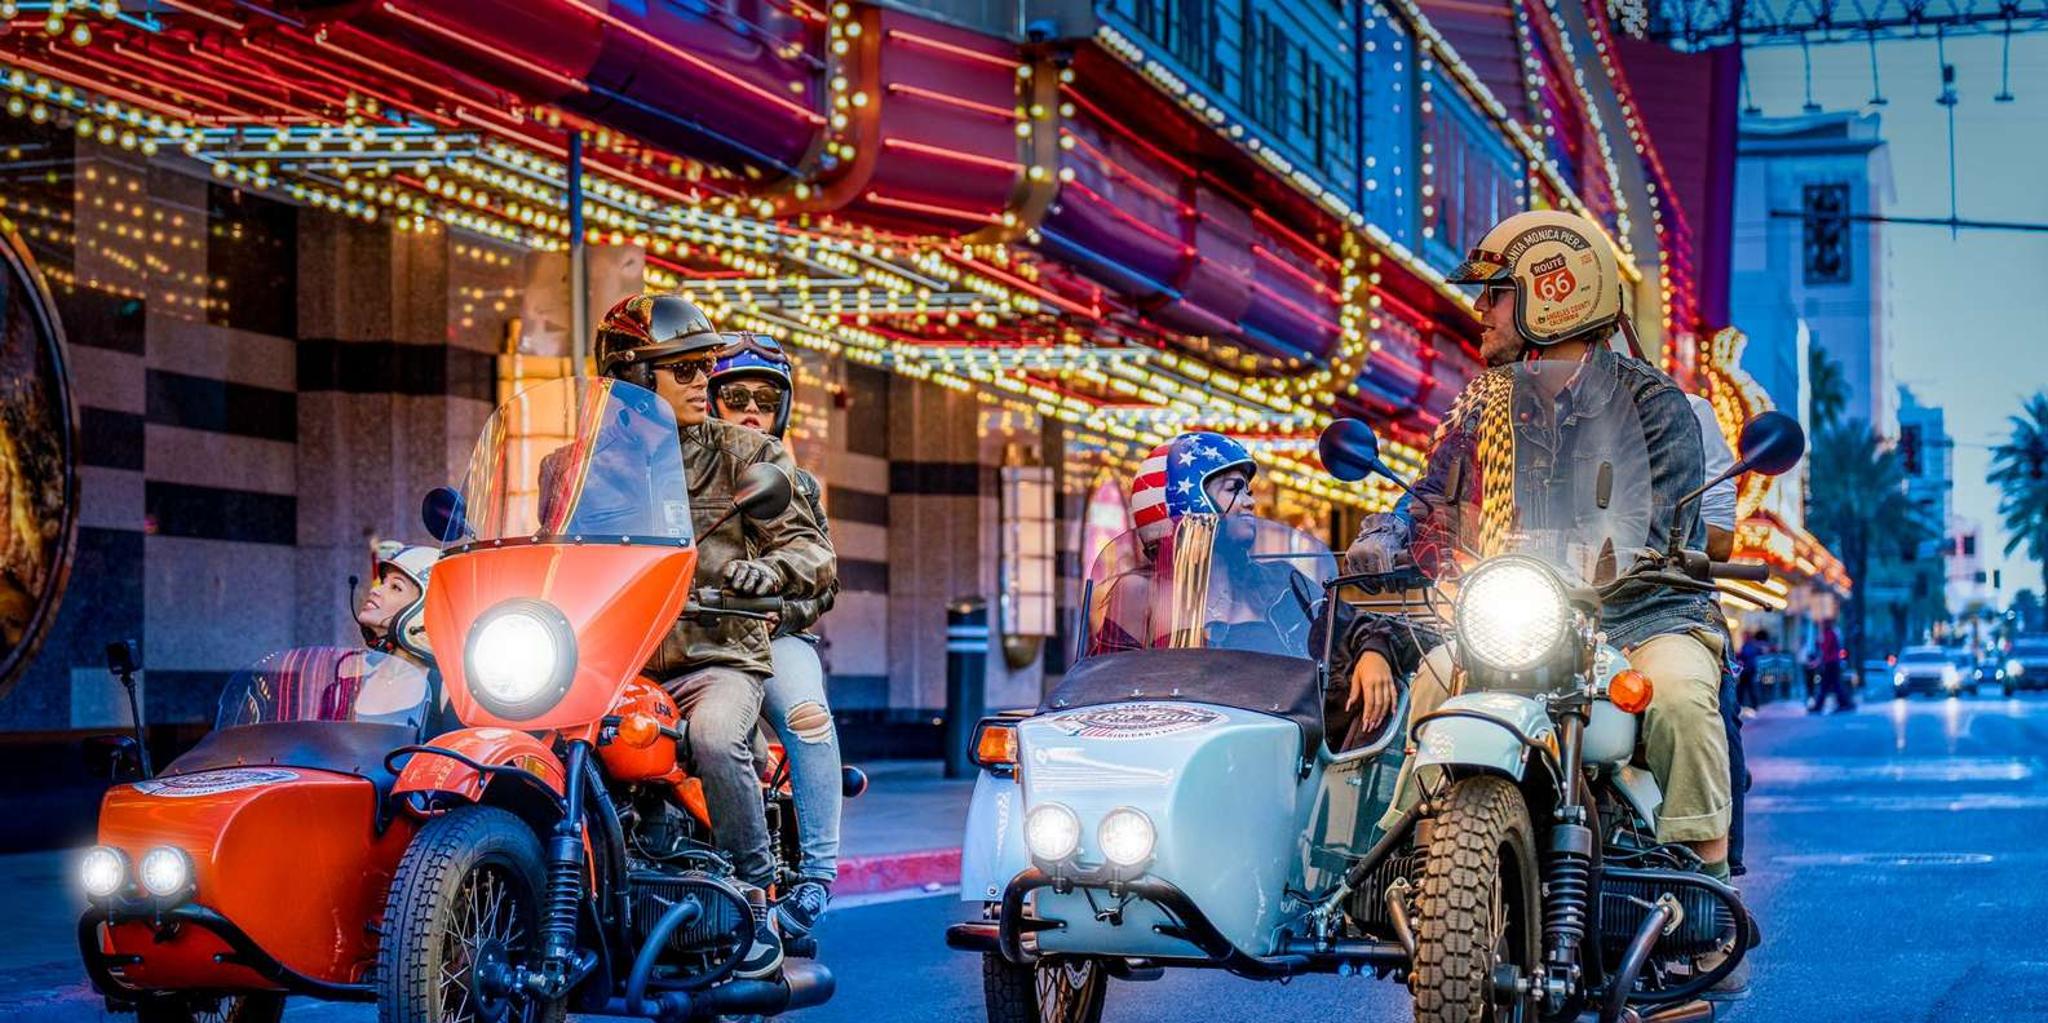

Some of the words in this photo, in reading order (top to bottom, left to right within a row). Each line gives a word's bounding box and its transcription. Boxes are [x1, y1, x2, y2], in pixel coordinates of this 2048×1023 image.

[1524, 229, 1559, 246] MONICA
[1560, 230, 1580, 249] PIER
[1533, 257, 1564, 273] ROUTE
[1540, 272, 1571, 298] 66
